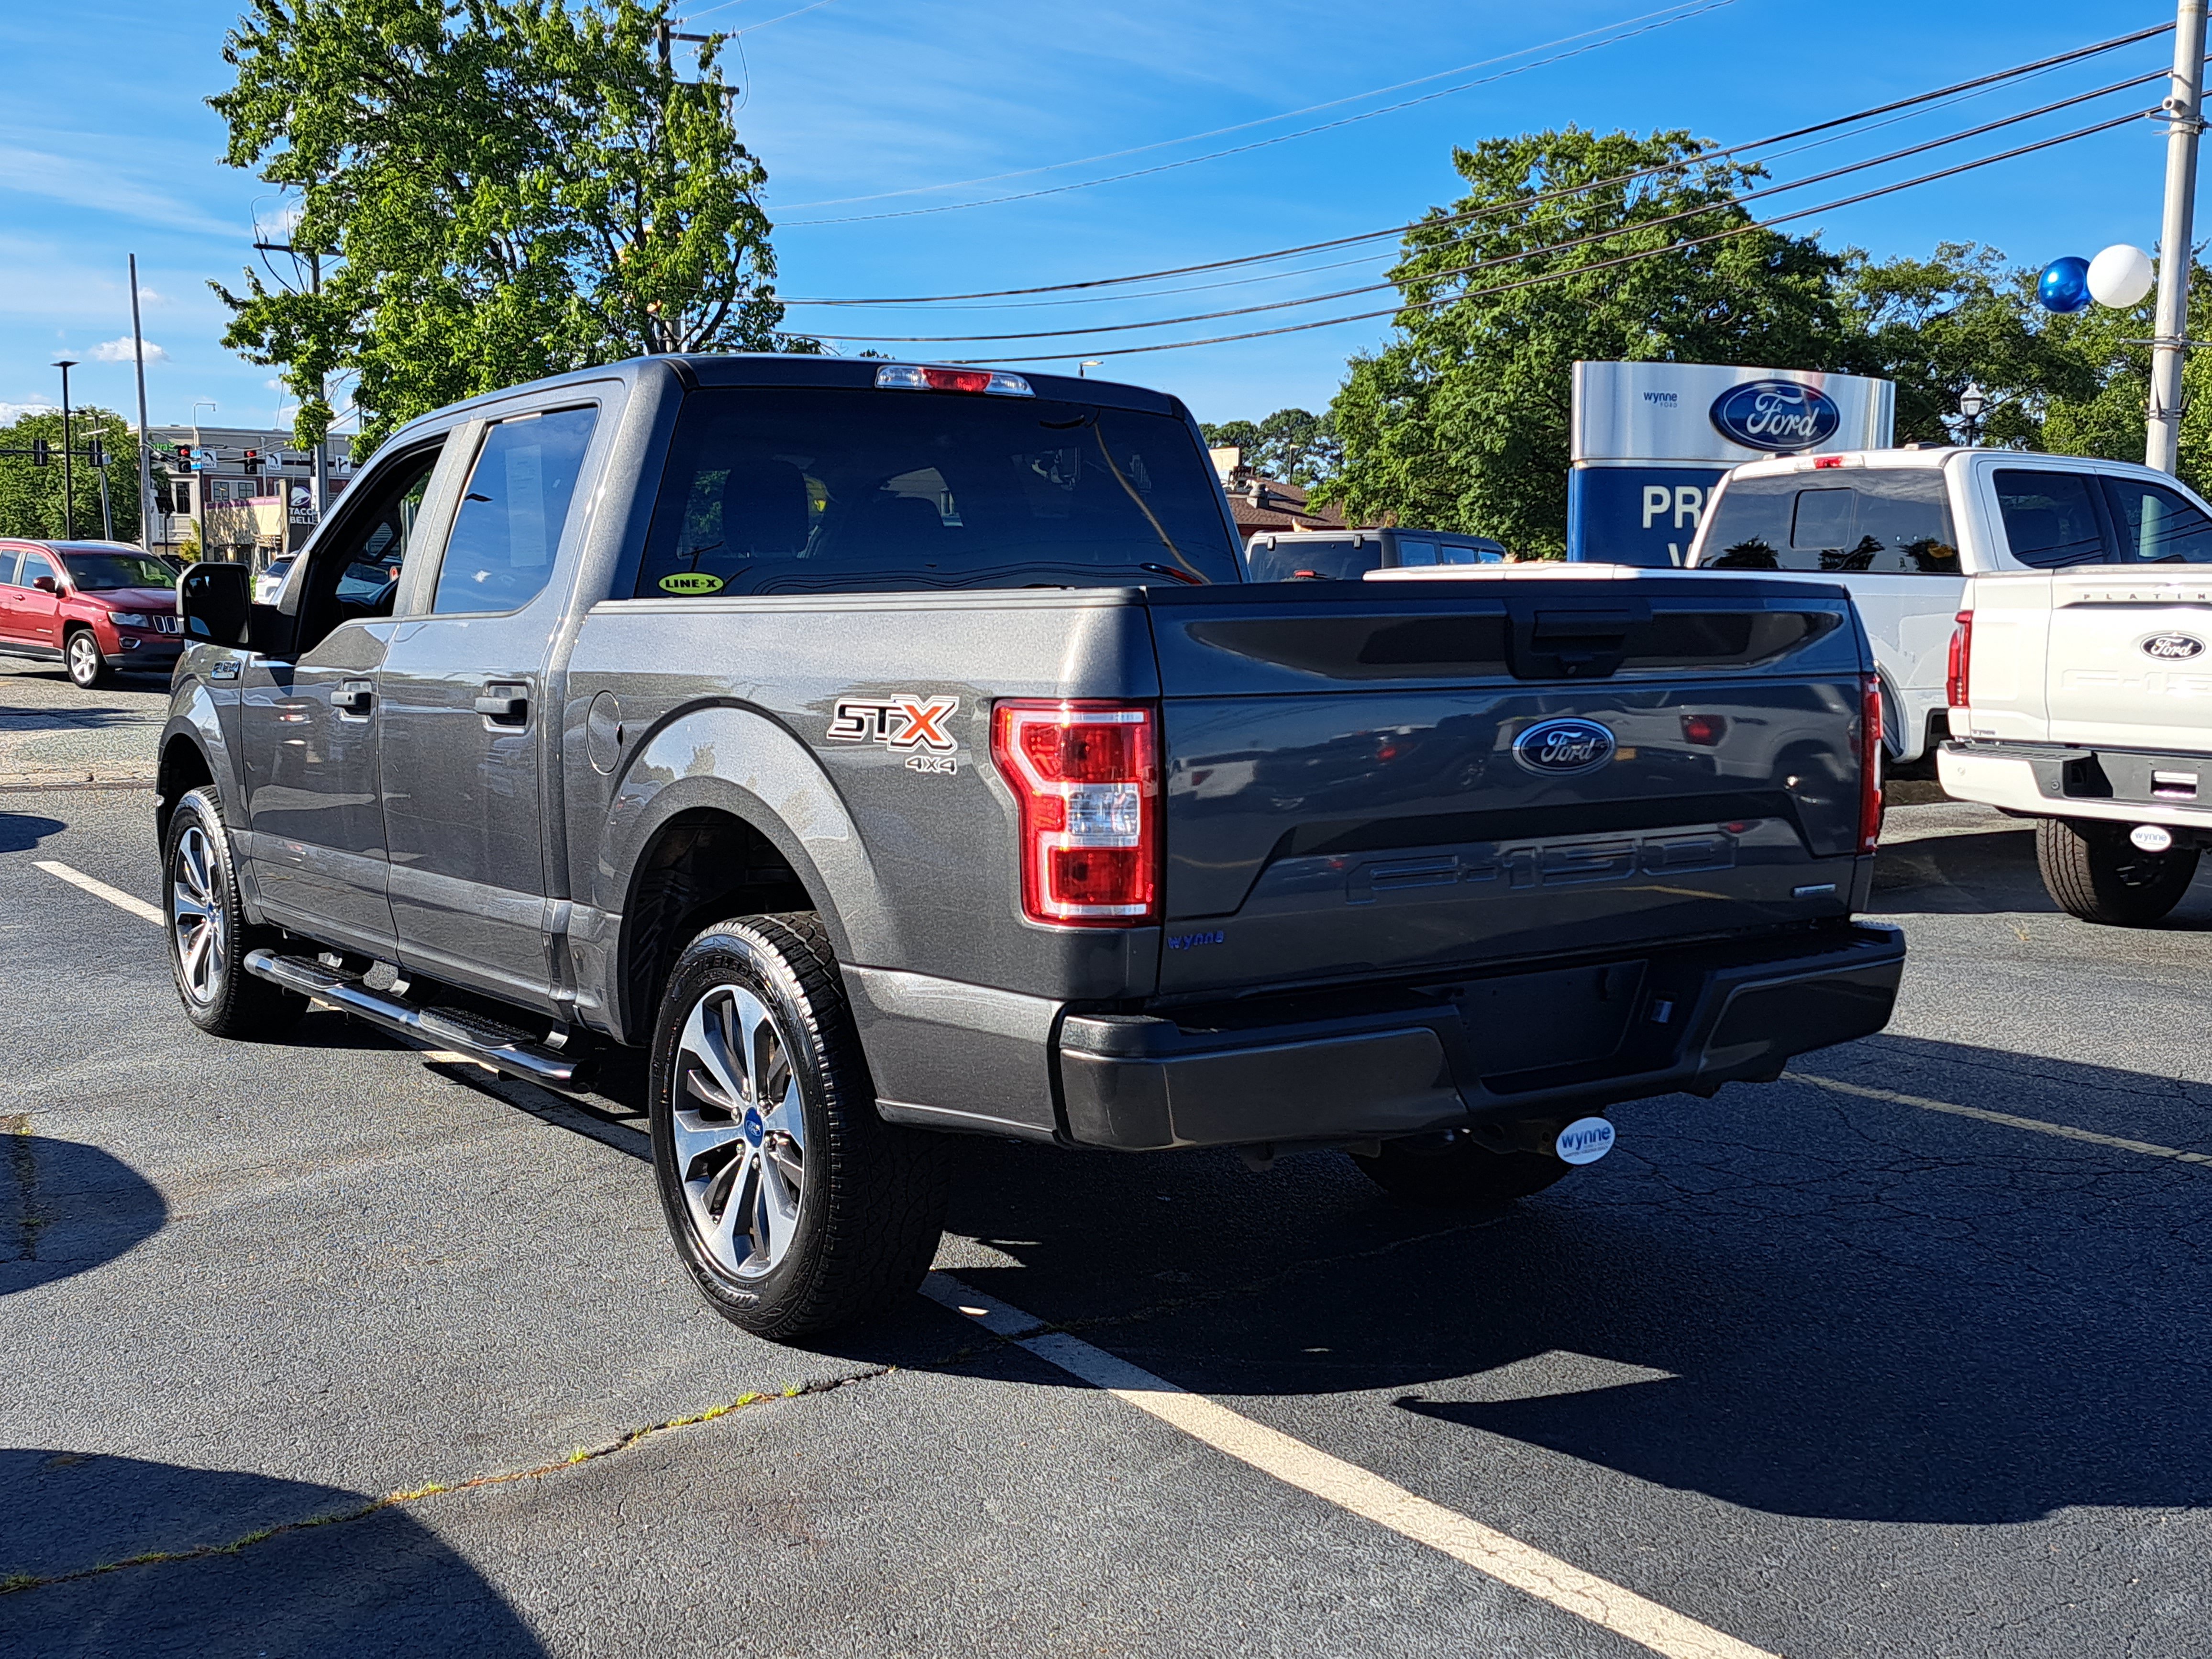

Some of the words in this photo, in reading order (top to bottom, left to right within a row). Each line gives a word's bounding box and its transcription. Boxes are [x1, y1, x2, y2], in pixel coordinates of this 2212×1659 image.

[1643, 392, 1677, 404] wynne
[1746, 390, 1820, 437] Ford
[288, 508, 313, 516] TACO
[289, 516, 314, 525] BELL
[665, 579, 718, 588] LINE-X
[2151, 637, 2194, 656] Ford
[826, 693, 960, 756] STX
[1540, 730, 1596, 763] Ford
[2135, 832, 2167, 842] wynne
[1346, 831, 1739, 905] F-150
[1167, 930, 1224, 951] wynne
[1561, 1126, 1611, 1151] wynne
